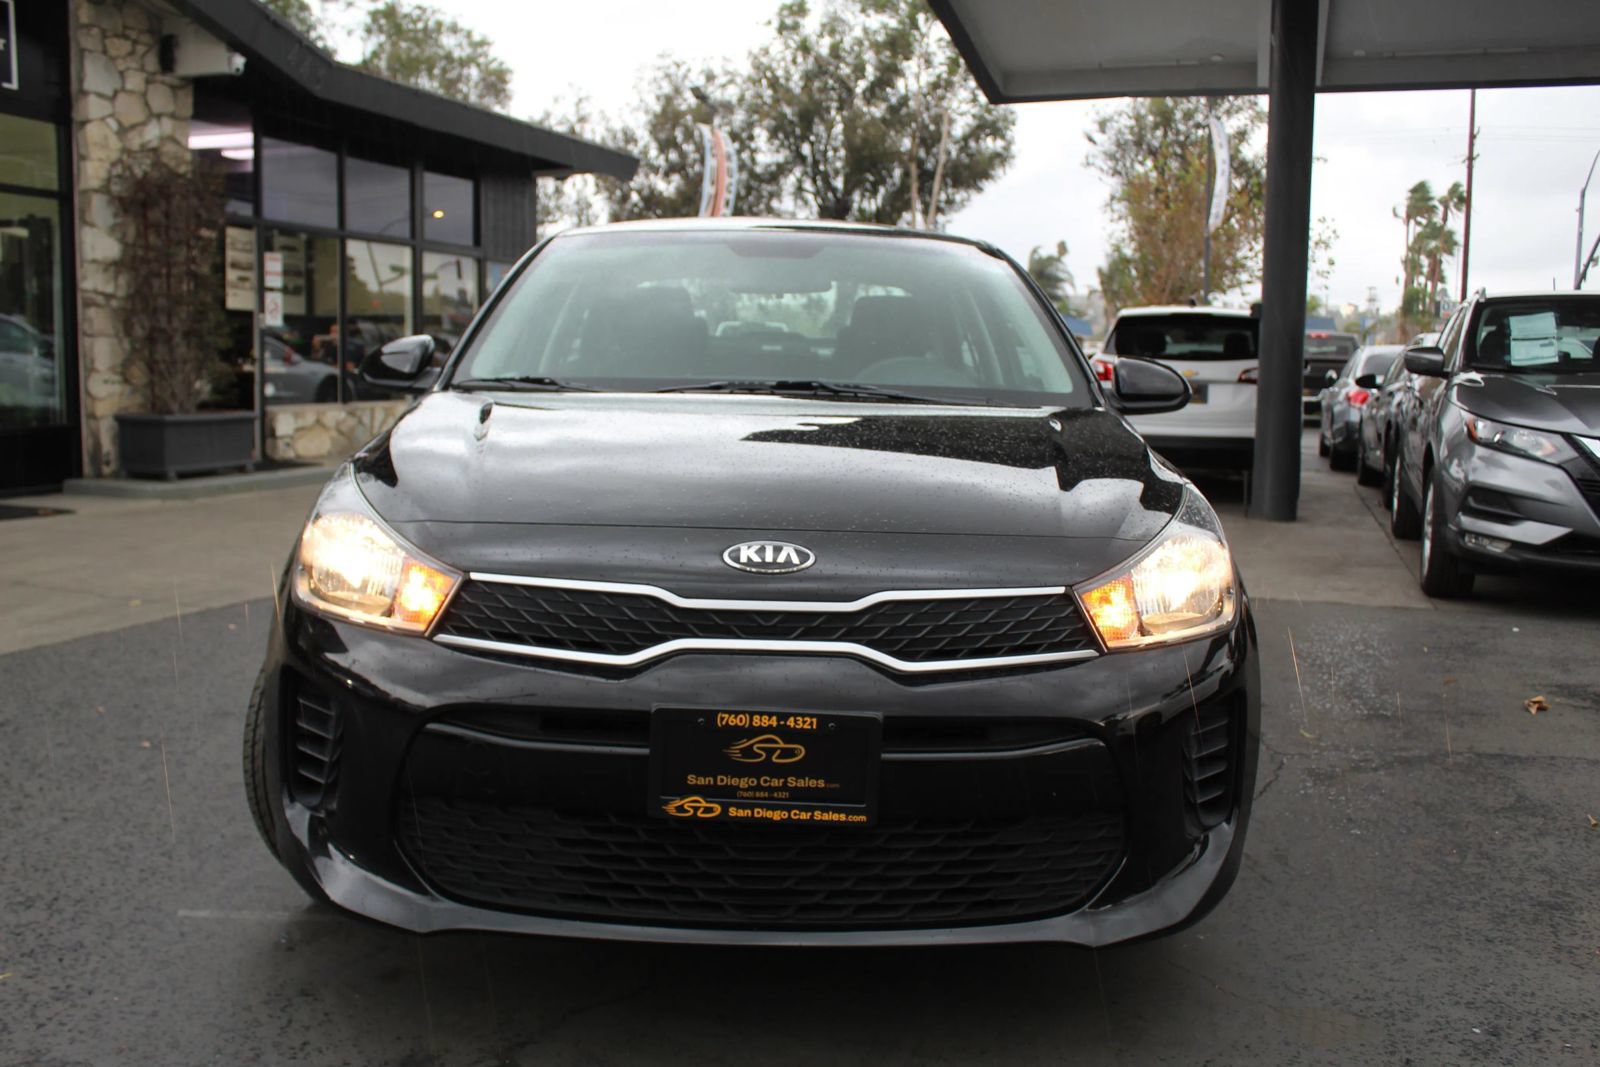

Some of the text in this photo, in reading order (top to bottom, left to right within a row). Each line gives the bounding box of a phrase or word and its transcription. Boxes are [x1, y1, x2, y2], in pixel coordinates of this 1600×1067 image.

[740, 544, 801, 565] KIA
[717, 713, 750, 728] (760)
[687, 774, 714, 785] San
[717, 775, 757, 789] Diego
[760, 776, 784, 787] Car
[728, 807, 752, 817] San
[754, 808, 789, 821] Diego
[790, 810, 812, 820] Car
